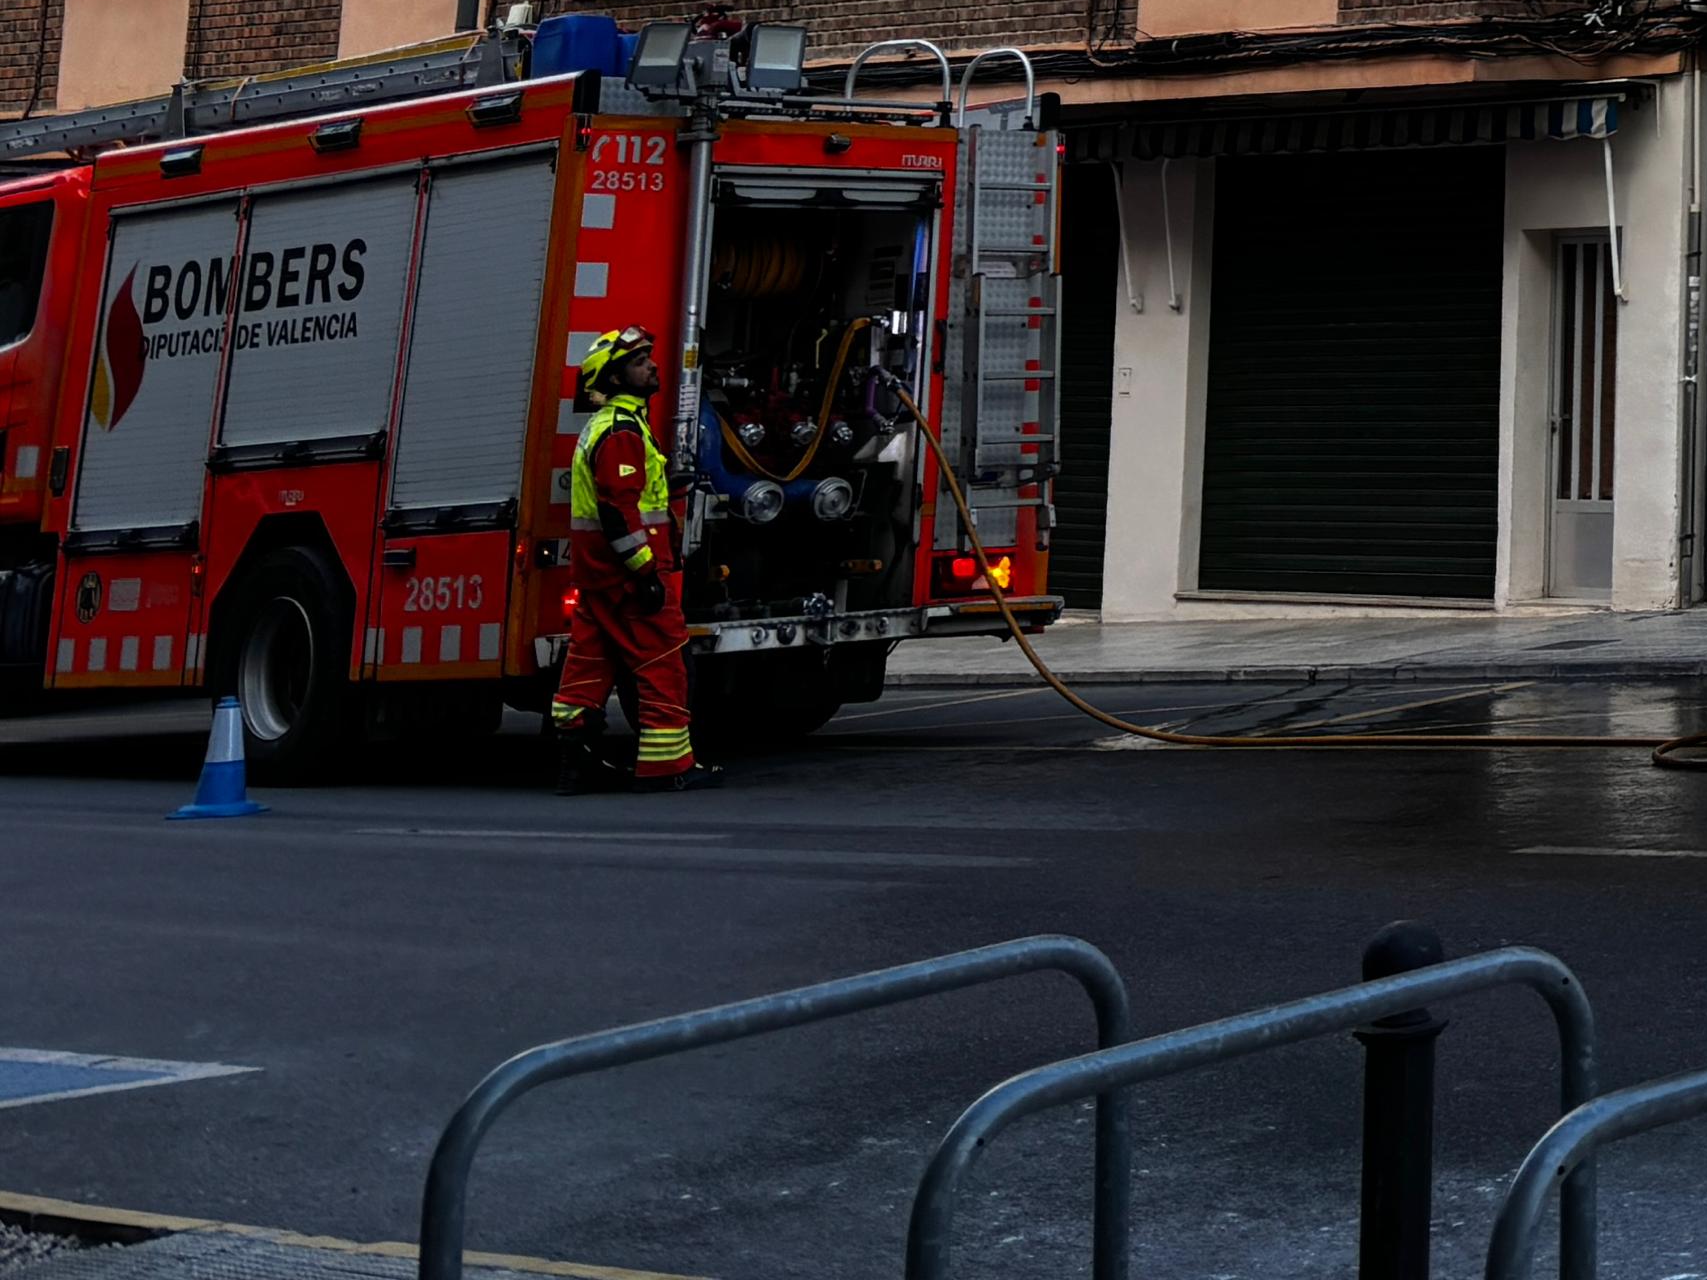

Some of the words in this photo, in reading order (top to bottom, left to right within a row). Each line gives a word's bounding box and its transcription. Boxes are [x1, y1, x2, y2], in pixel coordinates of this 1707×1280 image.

[616, 134, 668, 165] 112
[590, 169, 665, 192] 28513
[143, 238, 367, 325] BOMBERS
[237, 323, 262, 351] DE
[267, 311, 358, 347] VALENCIA
[403, 574, 484, 613] 28513
